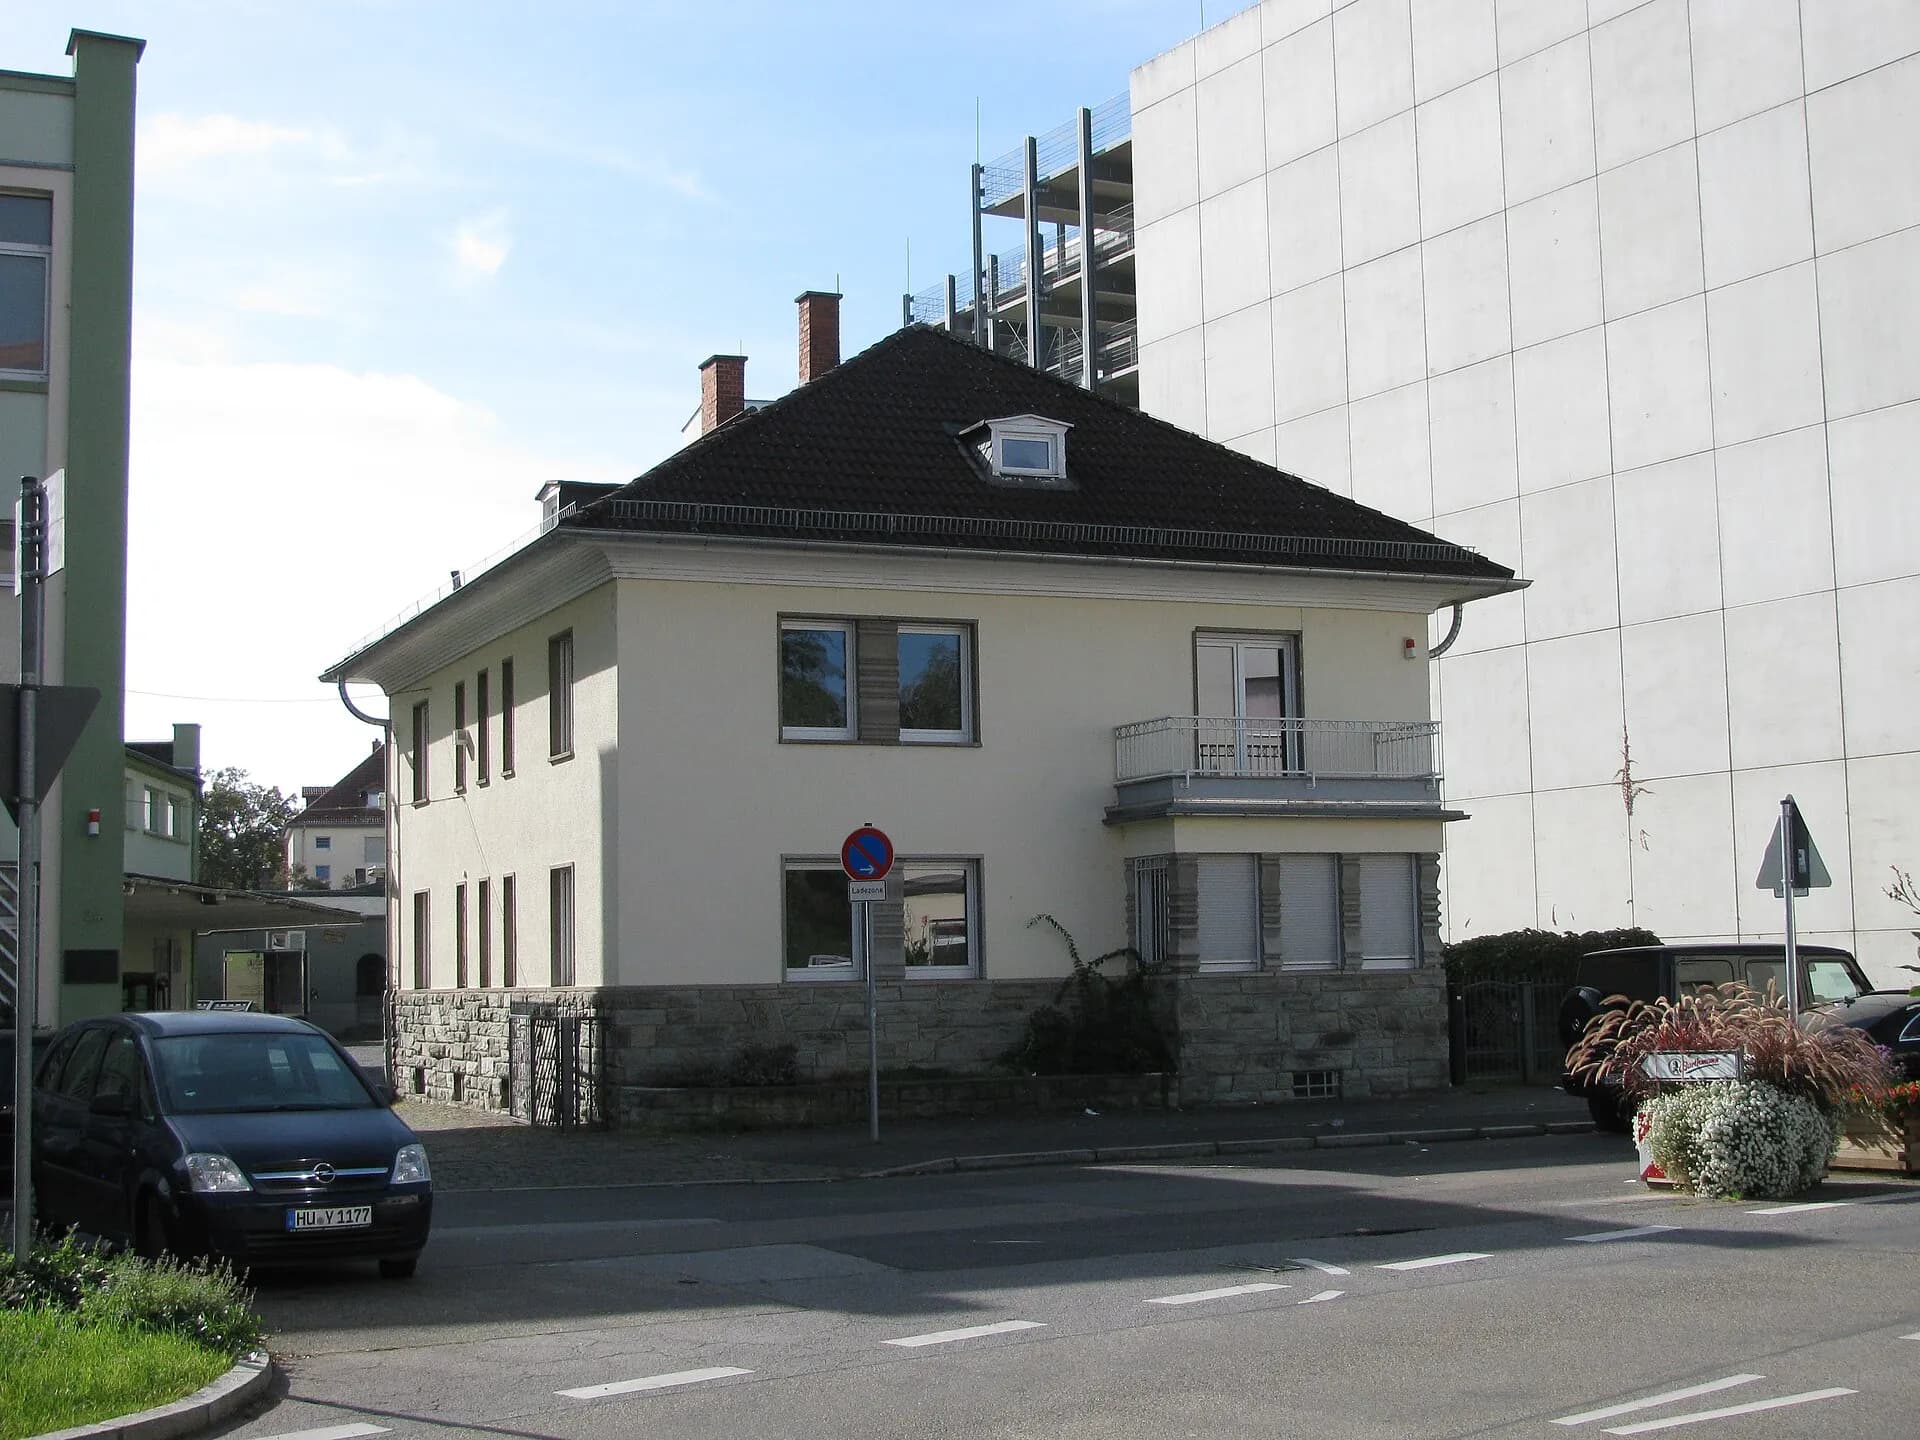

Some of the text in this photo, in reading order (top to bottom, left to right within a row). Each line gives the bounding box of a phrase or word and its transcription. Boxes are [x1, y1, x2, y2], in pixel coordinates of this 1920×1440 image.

[296, 1207, 370, 1226] HU Y 1177
